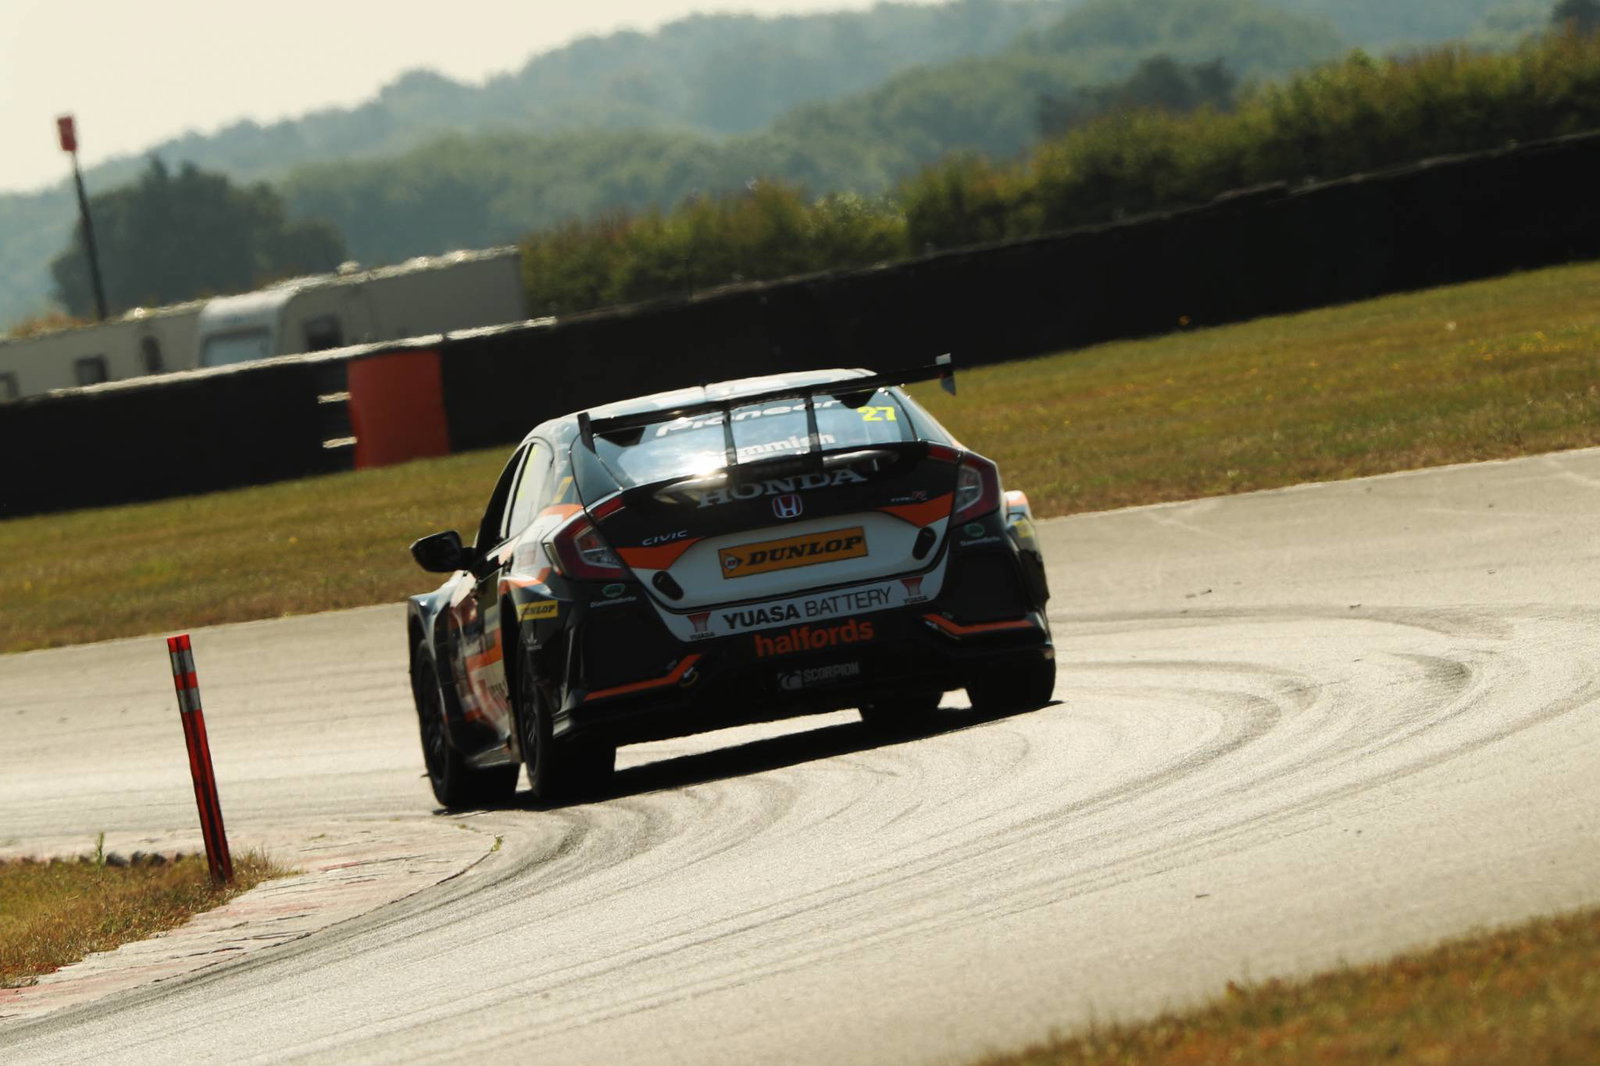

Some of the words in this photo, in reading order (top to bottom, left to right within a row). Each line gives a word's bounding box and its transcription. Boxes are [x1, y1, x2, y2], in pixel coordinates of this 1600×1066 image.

[858, 406, 897, 423] 27
[696, 469, 868, 508] HONDA
[642, 530, 689, 546] CIVIC
[747, 536, 863, 566] DUNLOP
[723, 603, 801, 631] YUASA
[804, 586, 892, 618] BATTERY
[754, 619, 876, 657] halfords
[803, 661, 860, 682] SCORPION
